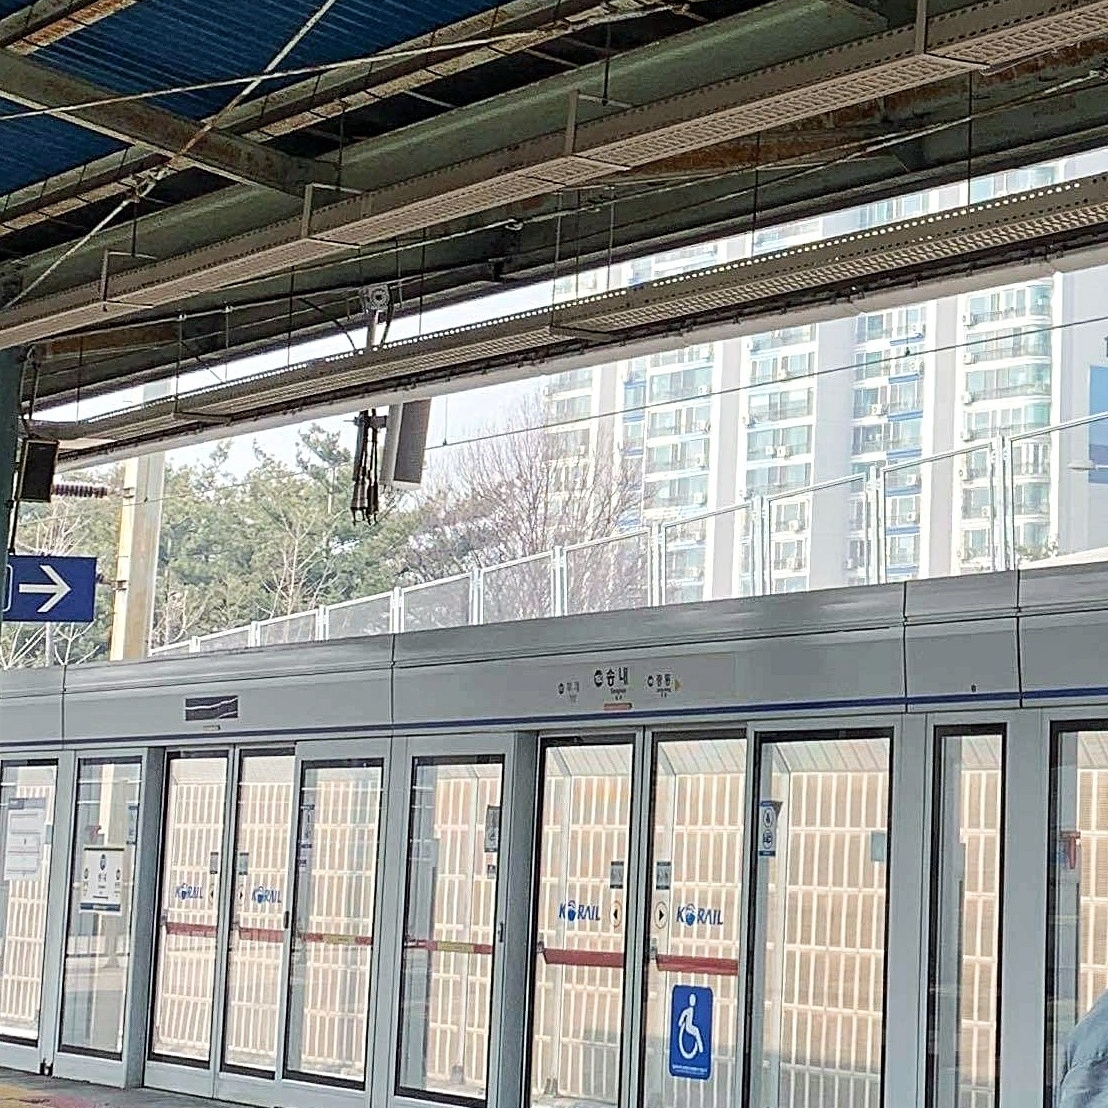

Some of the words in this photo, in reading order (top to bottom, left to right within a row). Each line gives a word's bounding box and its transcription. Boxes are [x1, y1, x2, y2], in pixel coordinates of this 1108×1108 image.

[606, 667, 629, 687] 송내
[558, 900, 601, 922] KORAIL
[676, 903, 724, 927] KORAIL
